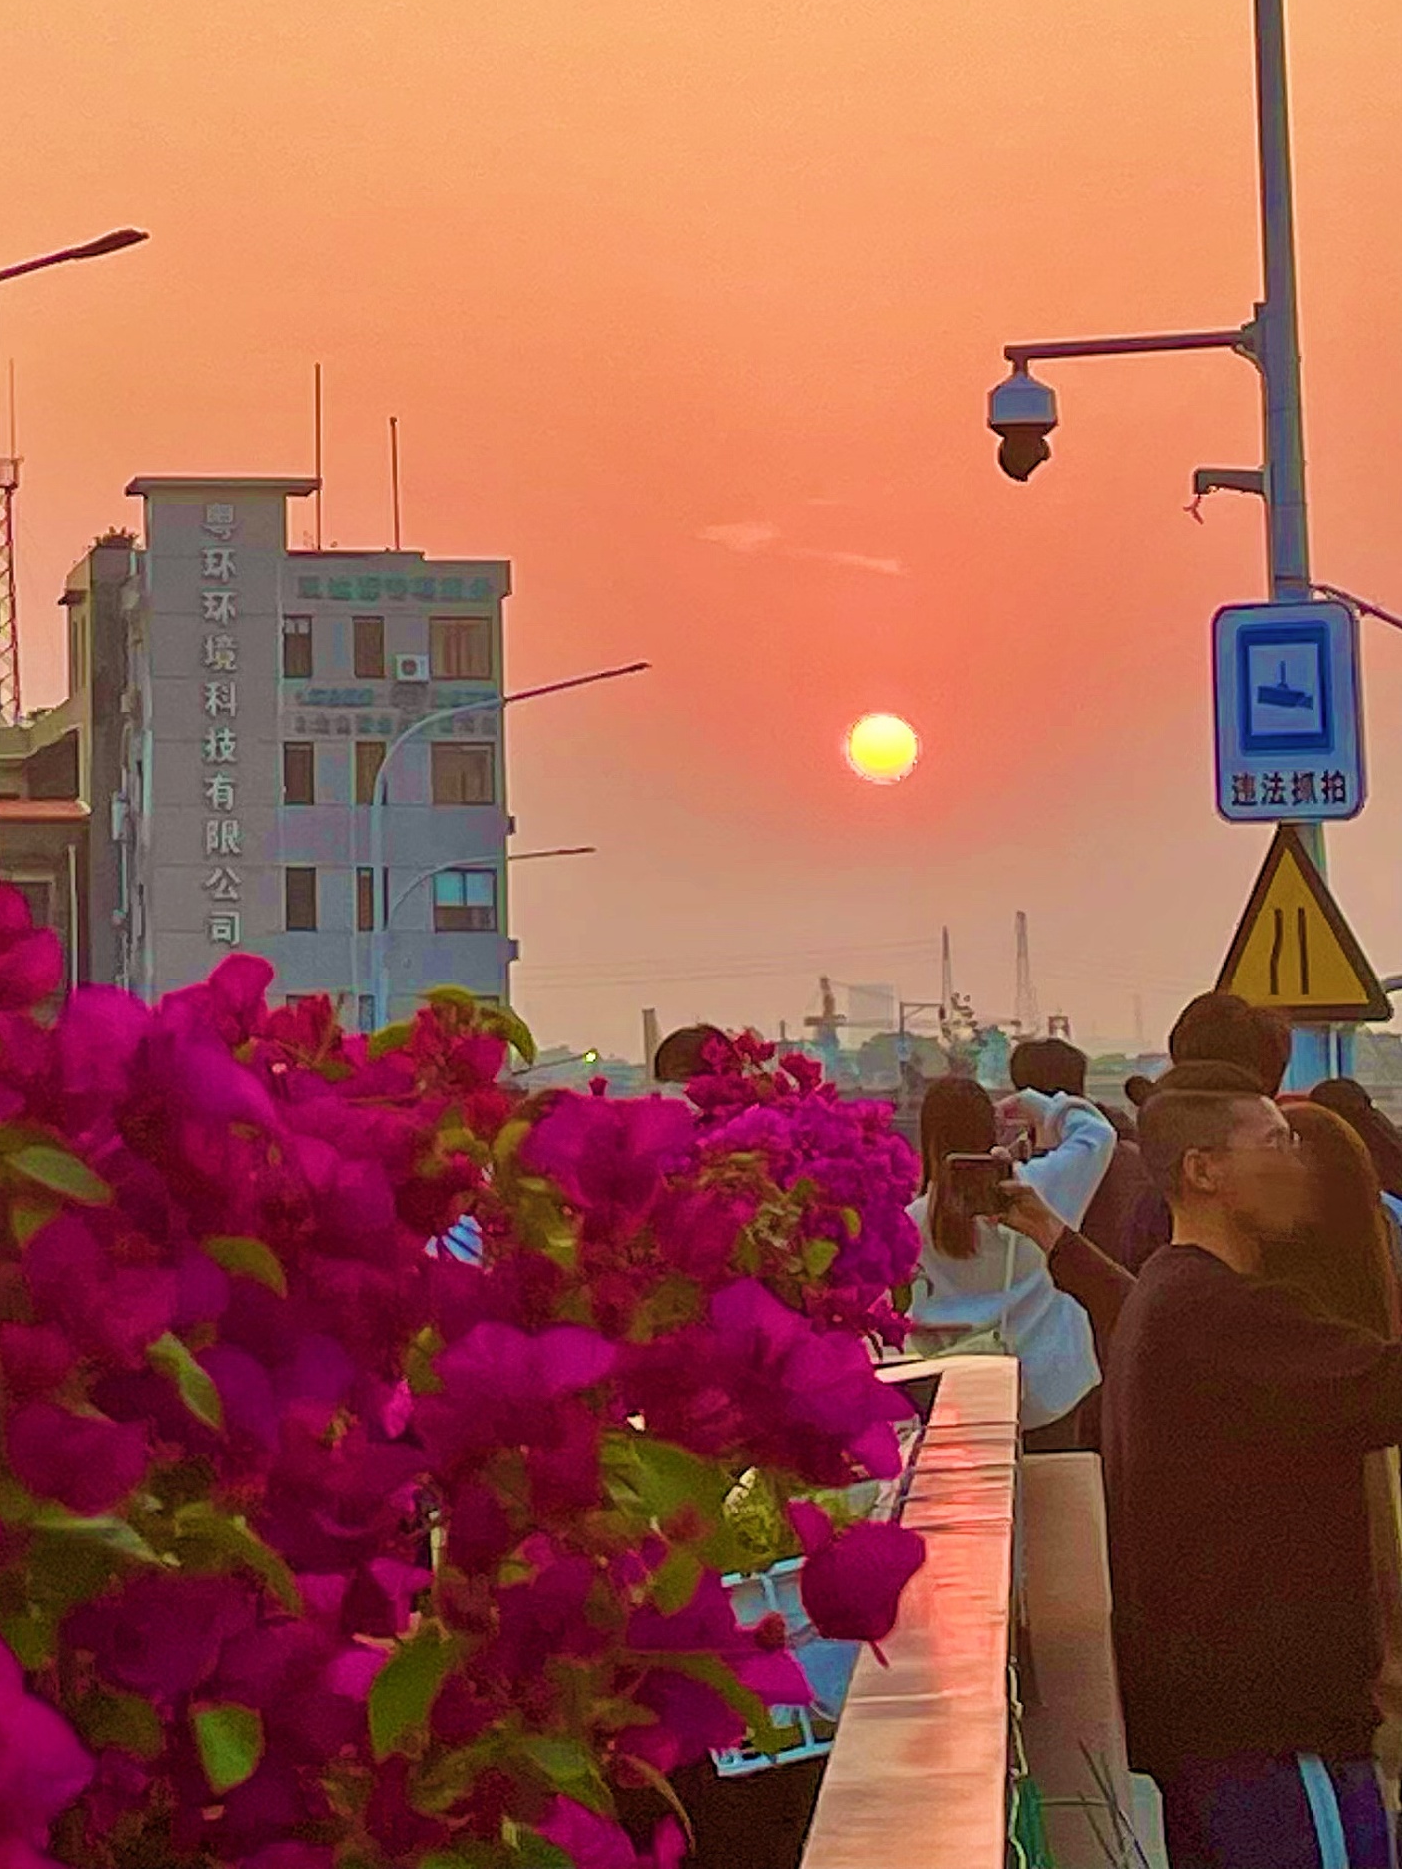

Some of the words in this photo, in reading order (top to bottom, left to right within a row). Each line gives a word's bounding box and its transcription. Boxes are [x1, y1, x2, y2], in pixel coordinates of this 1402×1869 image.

[202, 503, 241, 947] 粤环环境科技有限公司
[1231, 769, 1346, 806] 违法抓拍
